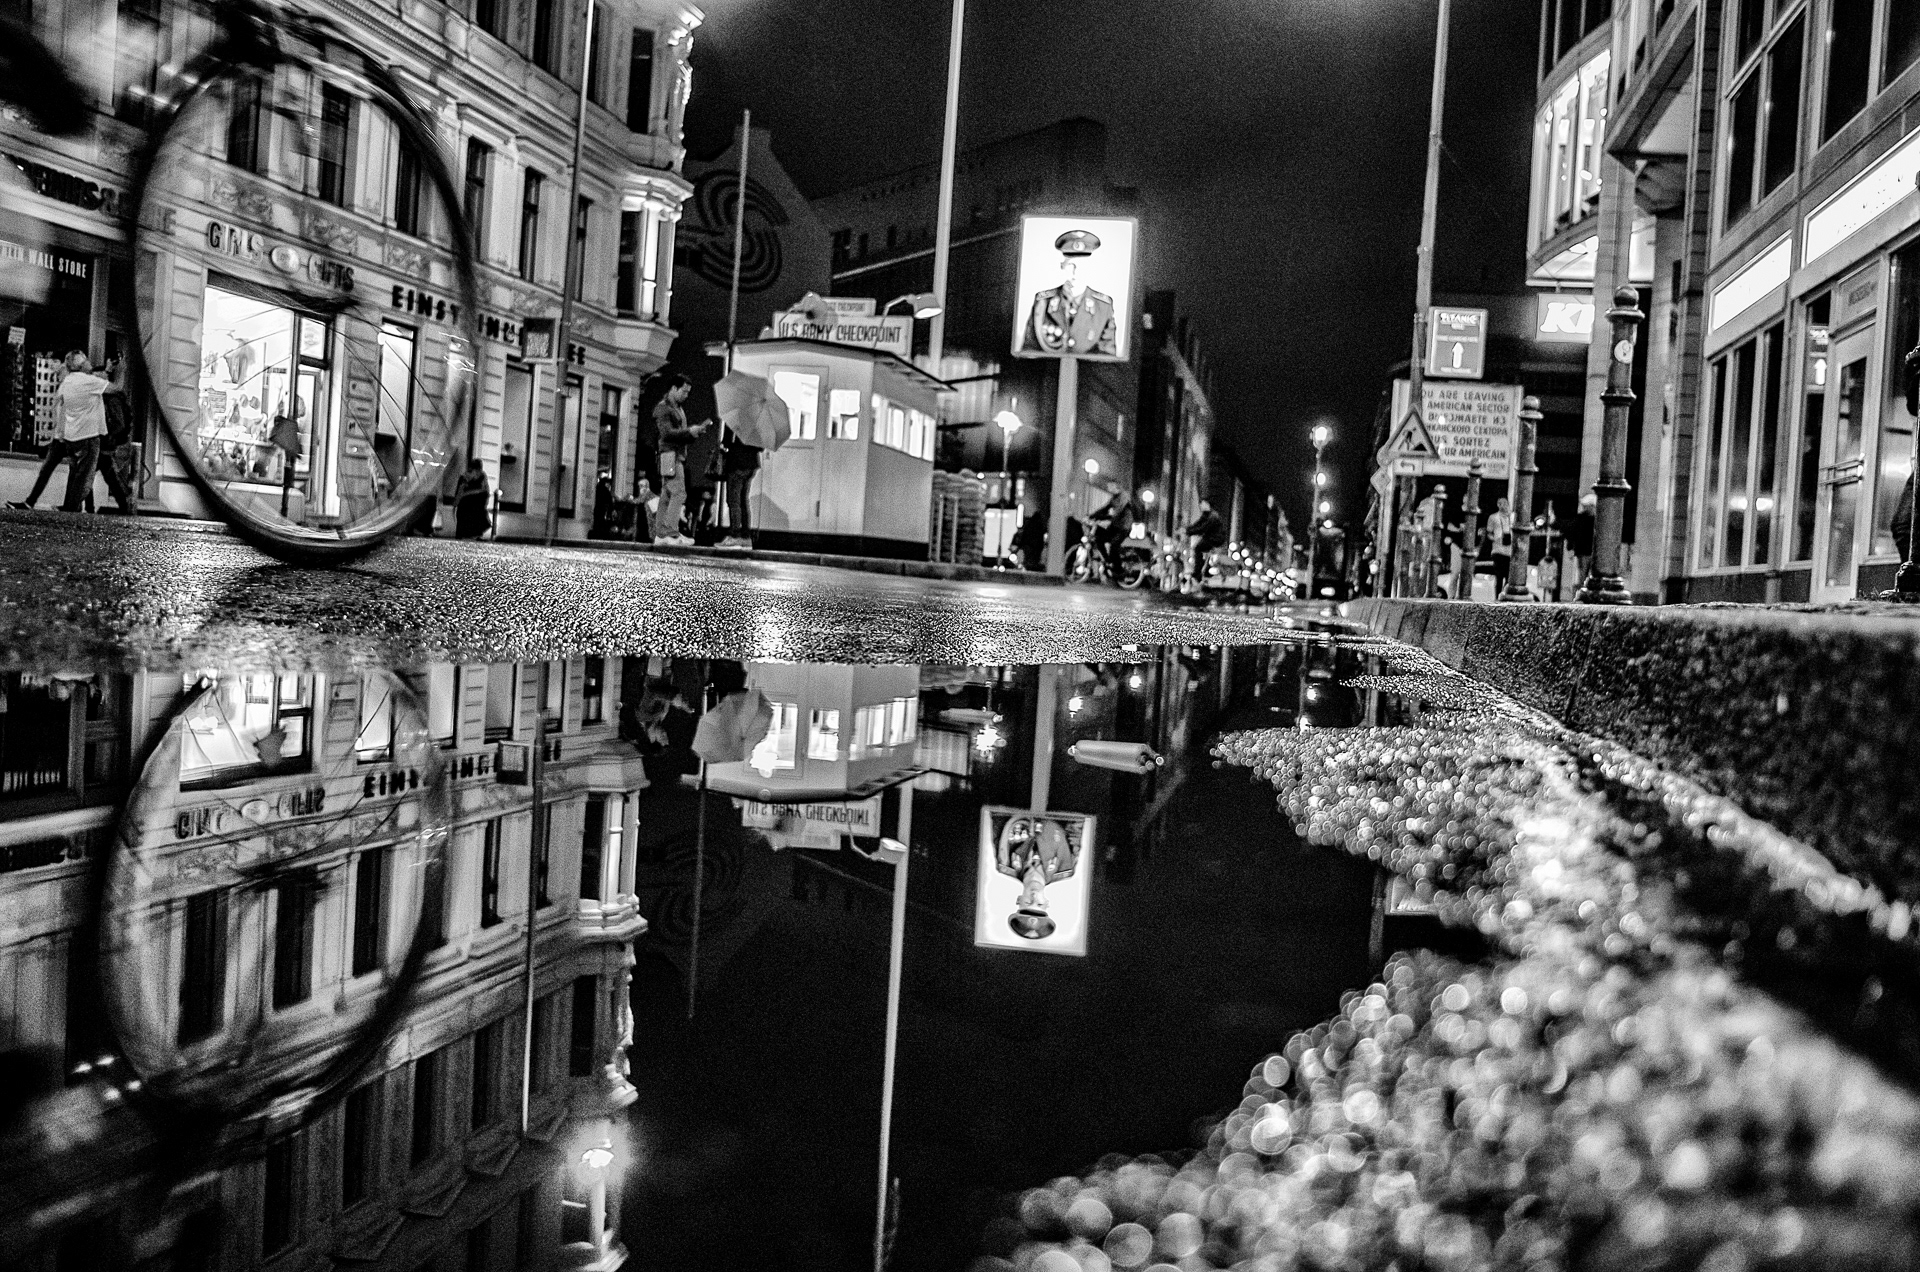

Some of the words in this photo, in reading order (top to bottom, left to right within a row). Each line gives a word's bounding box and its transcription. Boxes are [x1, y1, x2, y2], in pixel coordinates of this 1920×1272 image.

[207, 221, 265, 262] GIRLS
[308, 254, 355, 292] GIFTS
[29, 248, 54, 271] WALL
[58, 257, 87, 279] STORE
[391, 285, 500, 339] EINSTIN
[1440, 312, 1478, 325] TITANIC
[802, 324, 834, 341] ARMY
[836, 325, 902, 343] CHECKPOINT
[1439, 390, 1458, 400] ARE
[1463, 392, 1506, 402] LEAVING
[1427, 401, 1473, 412] AMERICAN
[1477, 404, 1510, 413] SECTOR
[1453, 436, 1491, 447] SORTEZ
[1458, 448, 1506, 459] AMERICAIN
